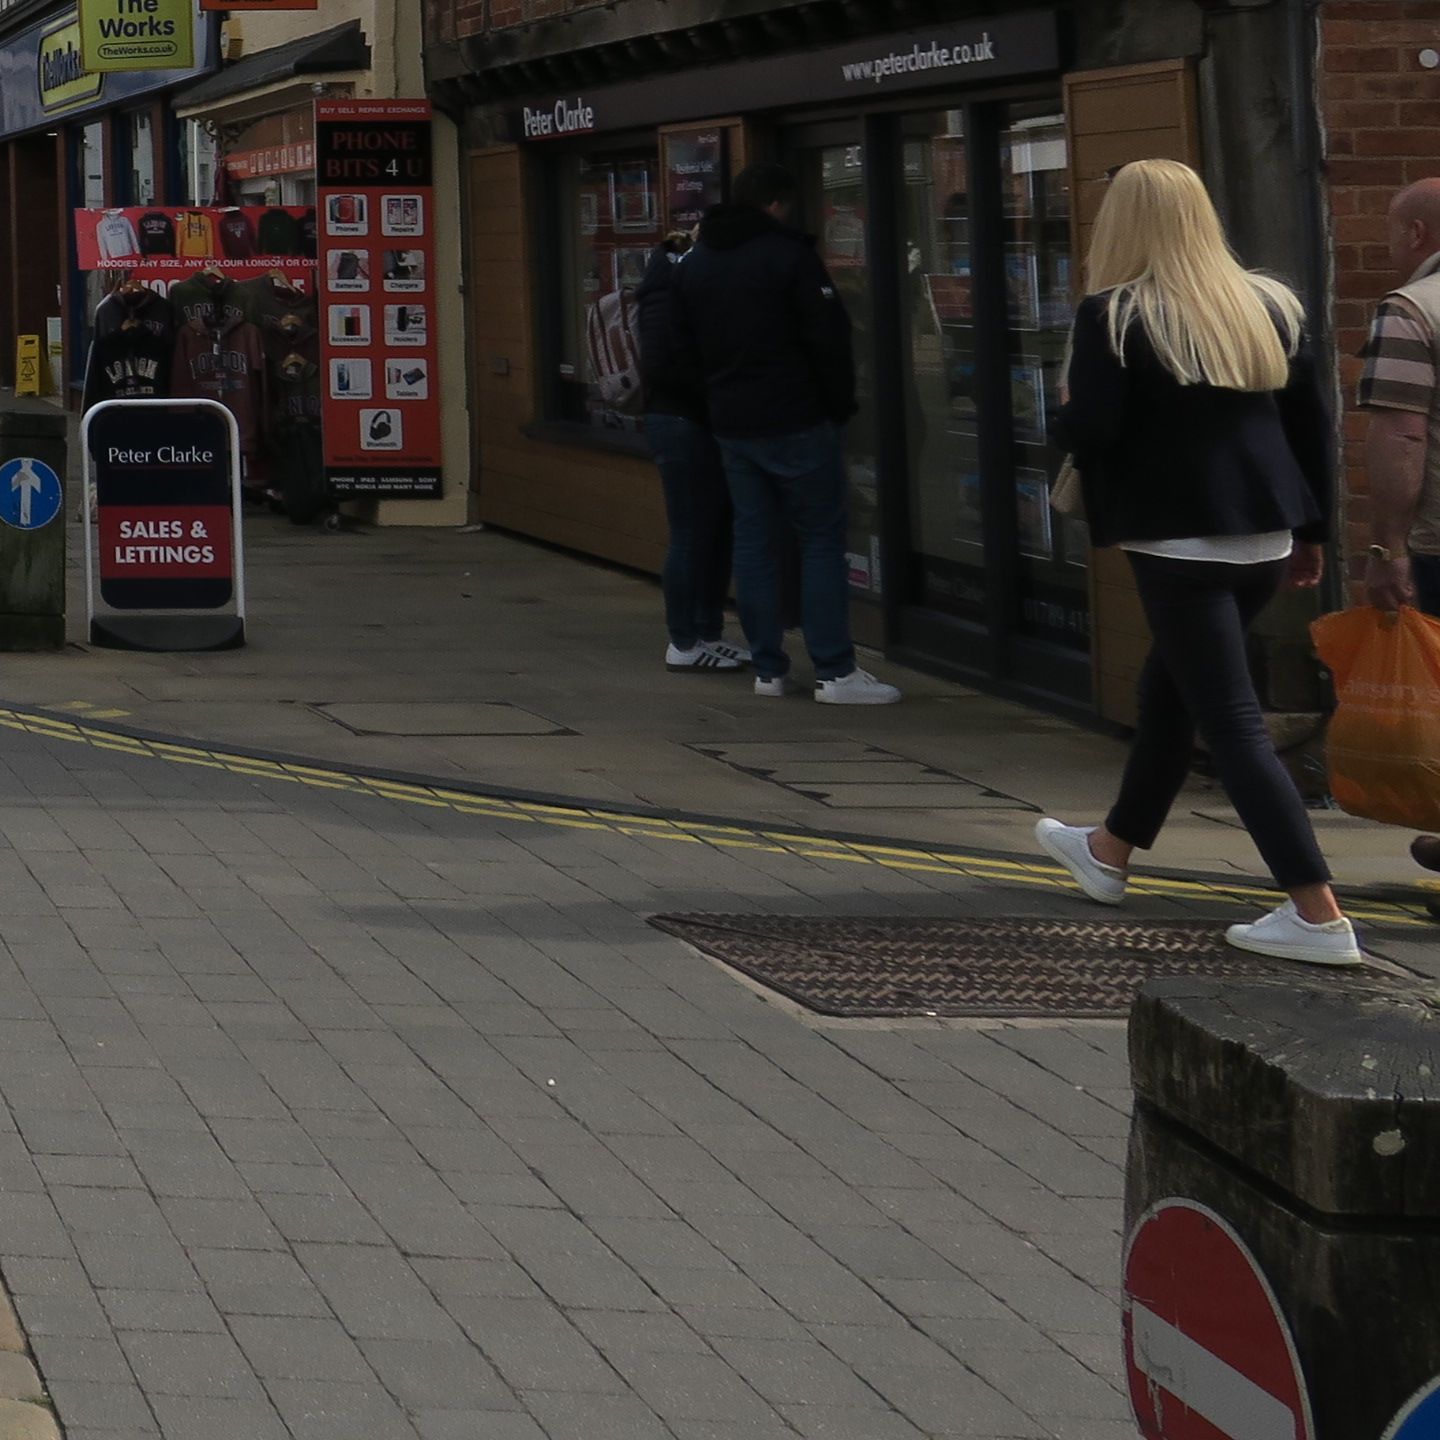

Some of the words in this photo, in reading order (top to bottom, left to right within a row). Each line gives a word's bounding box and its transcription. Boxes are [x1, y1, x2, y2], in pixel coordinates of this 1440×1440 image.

[98, 15, 175, 38] Works
[102, 44, 173, 56] TheWorks.co.uk
[841, 31, 995, 84] www.peterclarke.co.uk
[523, 107, 553, 137] Peter
[554, 96, 594, 133] Clarke
[332, 131, 416, 150] PHONE
[327, 158, 379, 177] BITS
[385, 158, 399, 176] 4
[406, 159, 423, 177] U
[97, 259, 138, 268] HOODIES
[140, 259, 158, 268] ANY
[184, 259, 202, 267] ANY
[204, 259, 243, 268] COLOUR
[245, 259, 284, 267] LONDON
[286, 259, 300, 267] OR
[108, 446, 152, 463] Peter
[157, 445, 213, 463] Clarke
[119, 521, 183, 539] SALES
[190, 520, 208, 539] &
[114, 545, 214, 564] LETTINGS
